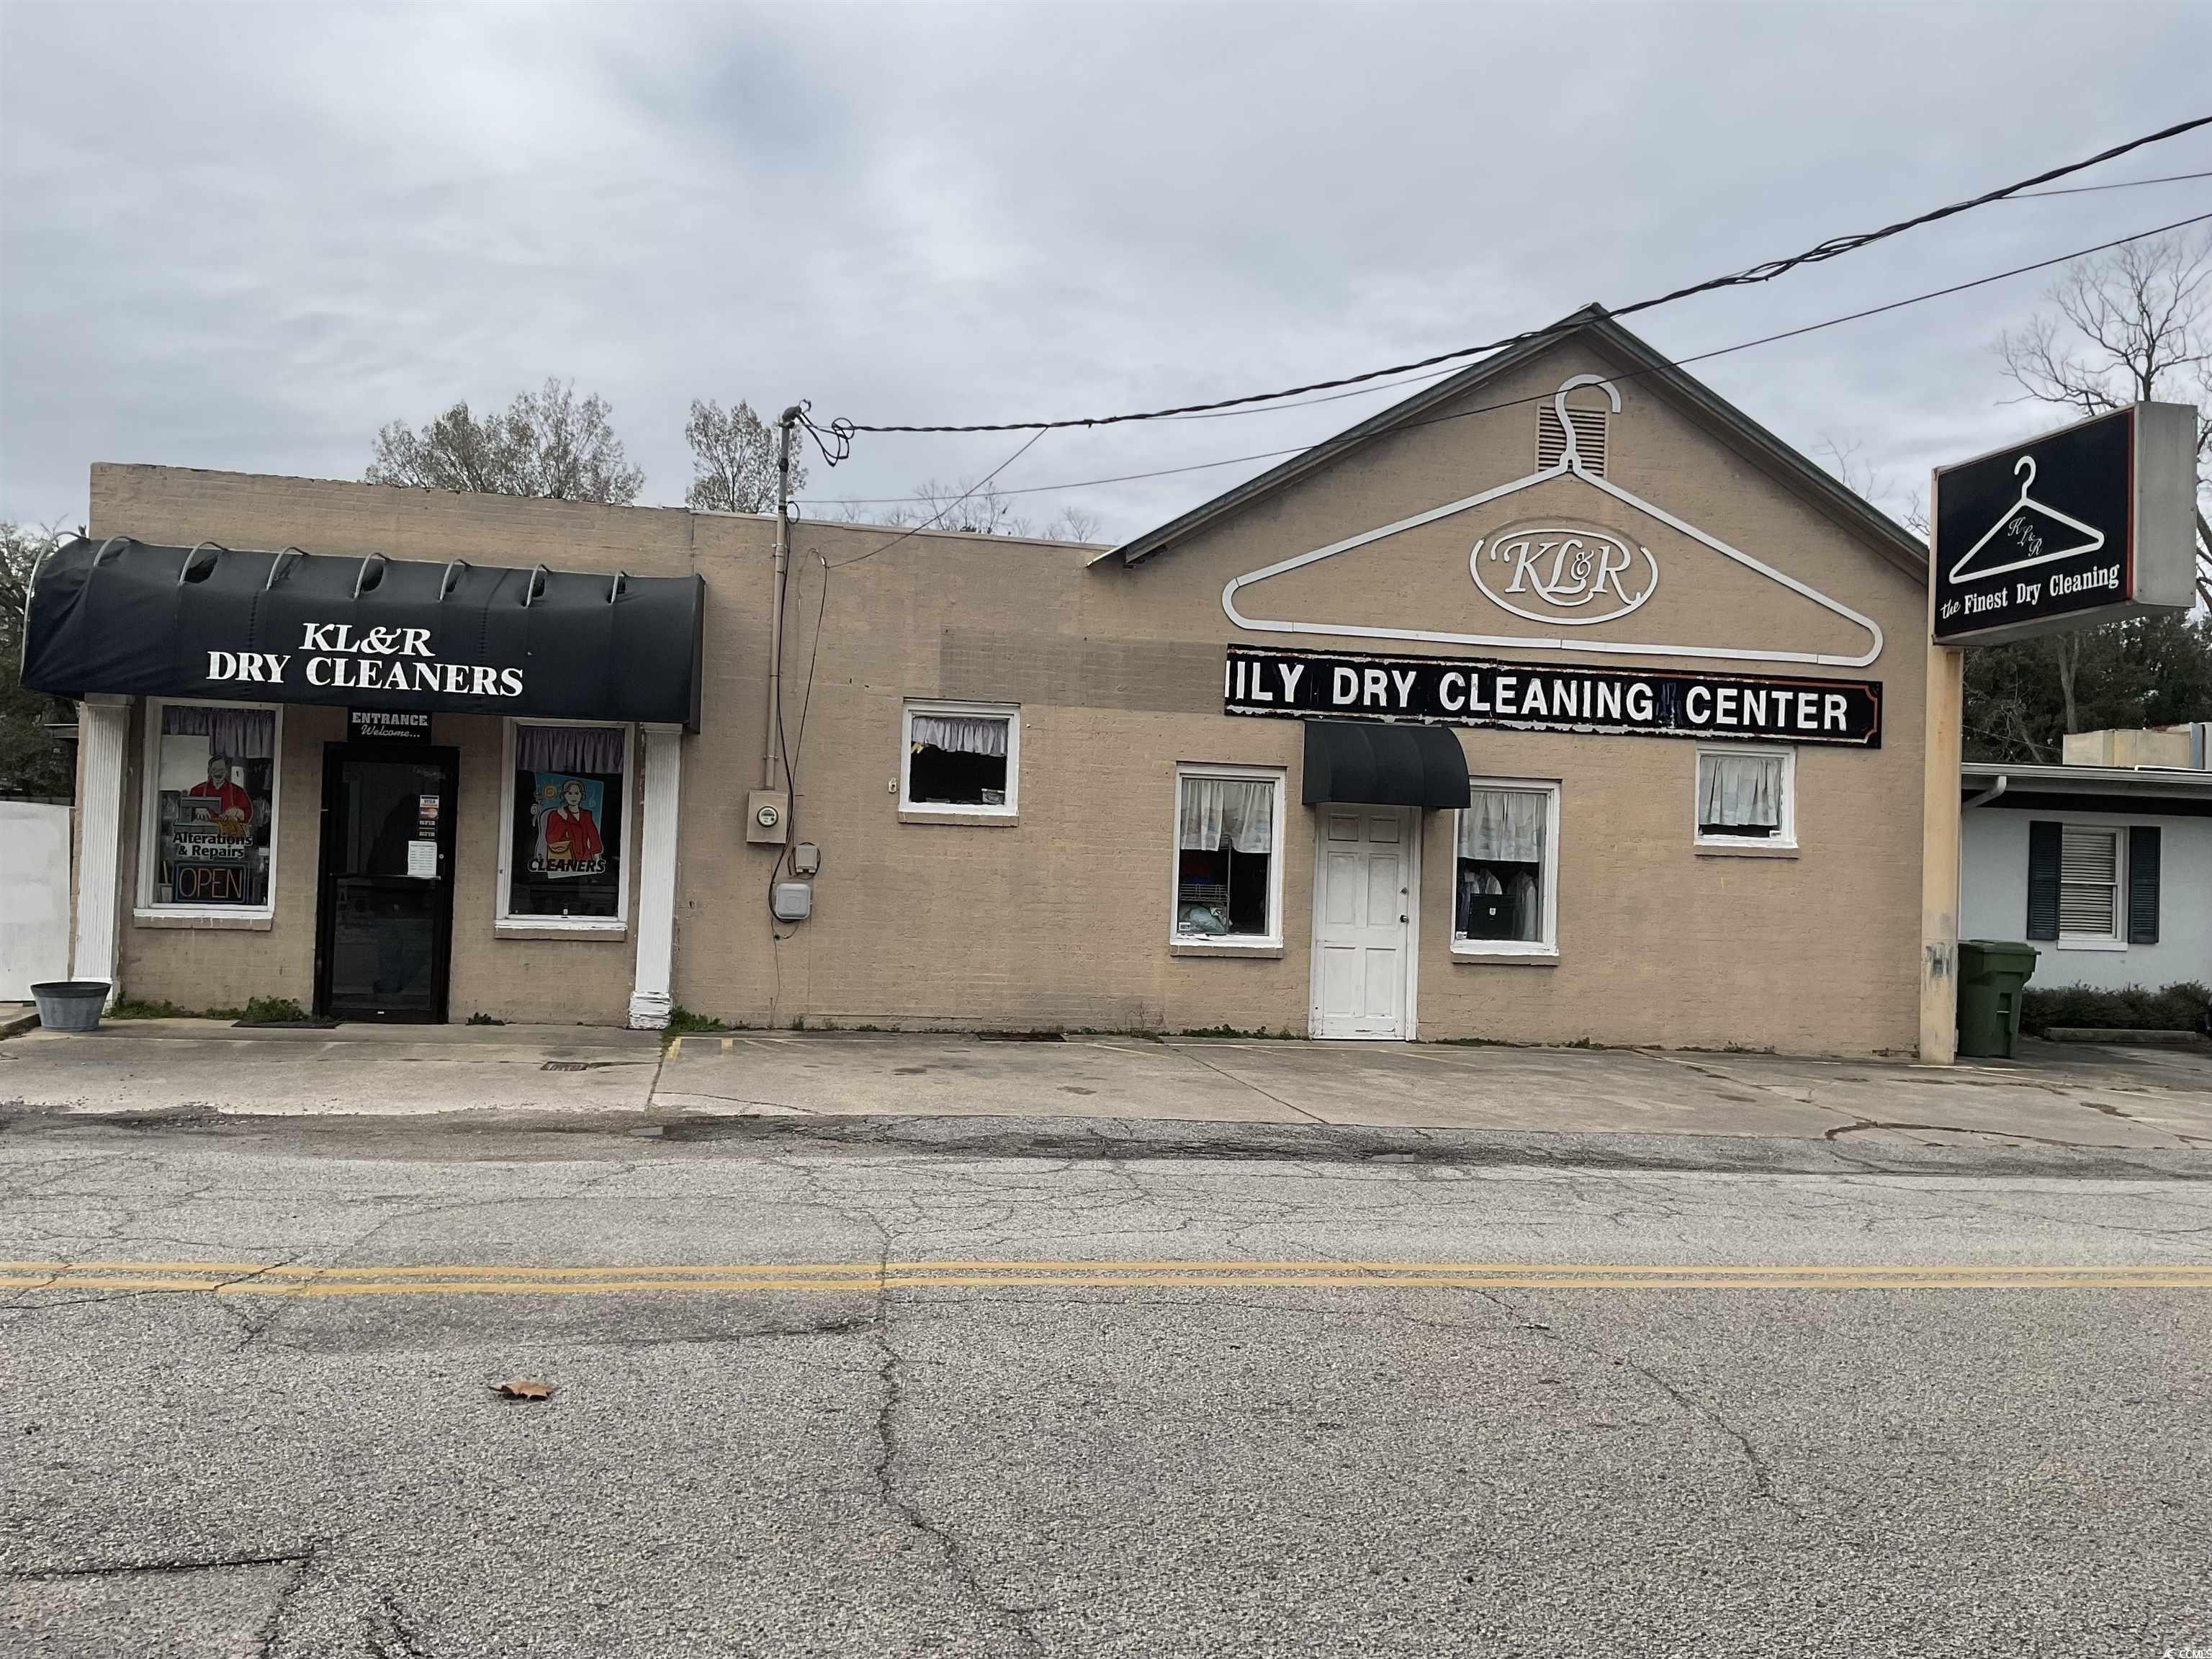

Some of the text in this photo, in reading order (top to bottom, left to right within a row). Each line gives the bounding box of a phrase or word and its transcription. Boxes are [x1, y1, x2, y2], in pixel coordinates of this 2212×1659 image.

[1491, 529, 1642, 606] KL&R
[1941, 564, 2120, 619] the Finest Dry Cleaning
[298, 622, 436, 657] KL&R
[206, 650, 524, 697] DRY CLEANERS
[1332, 666, 1417, 708] DRY
[1439, 671, 1653, 721] CLEANING
[1686, 685, 1848, 731] CENTER
[172, 832, 253, 845] Alterations
[178, 845, 245, 859] & Repairs
[528, 858, 606, 873] CLEANERS
[179, 868, 242, 899] OPEN
